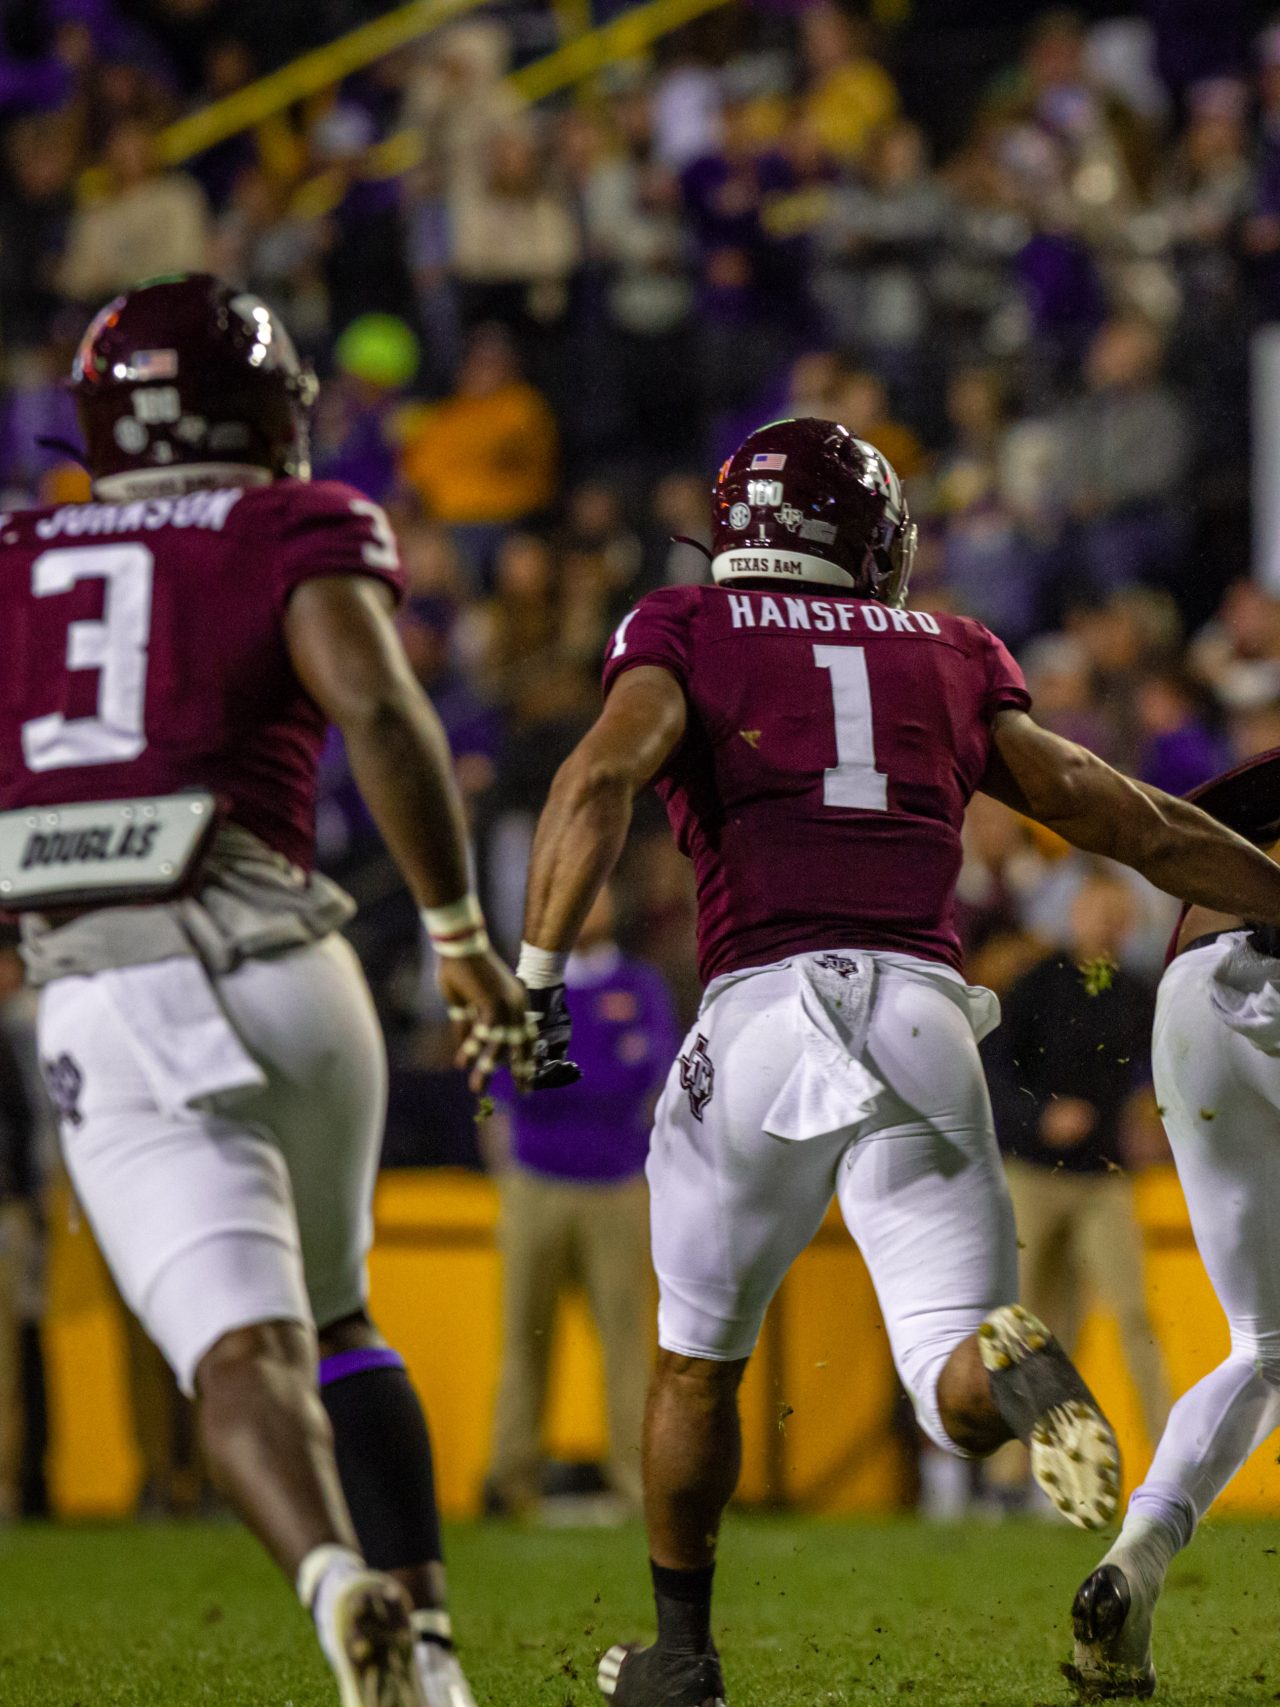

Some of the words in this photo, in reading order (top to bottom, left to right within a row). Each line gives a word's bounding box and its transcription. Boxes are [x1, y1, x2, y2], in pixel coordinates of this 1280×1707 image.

[36, 488, 243, 540] JOHNSON
[353, 500, 399, 570] 3
[729, 558, 768, 572] TEXAS
[773, 560, 802, 575] A&M
[611, 608, 640, 660] 1
[727, 594, 942, 635] HANSFORD
[22, 541, 155, 773] 3
[812, 644, 889, 812] 1
[20, 822, 161, 870] DOUGLAS
